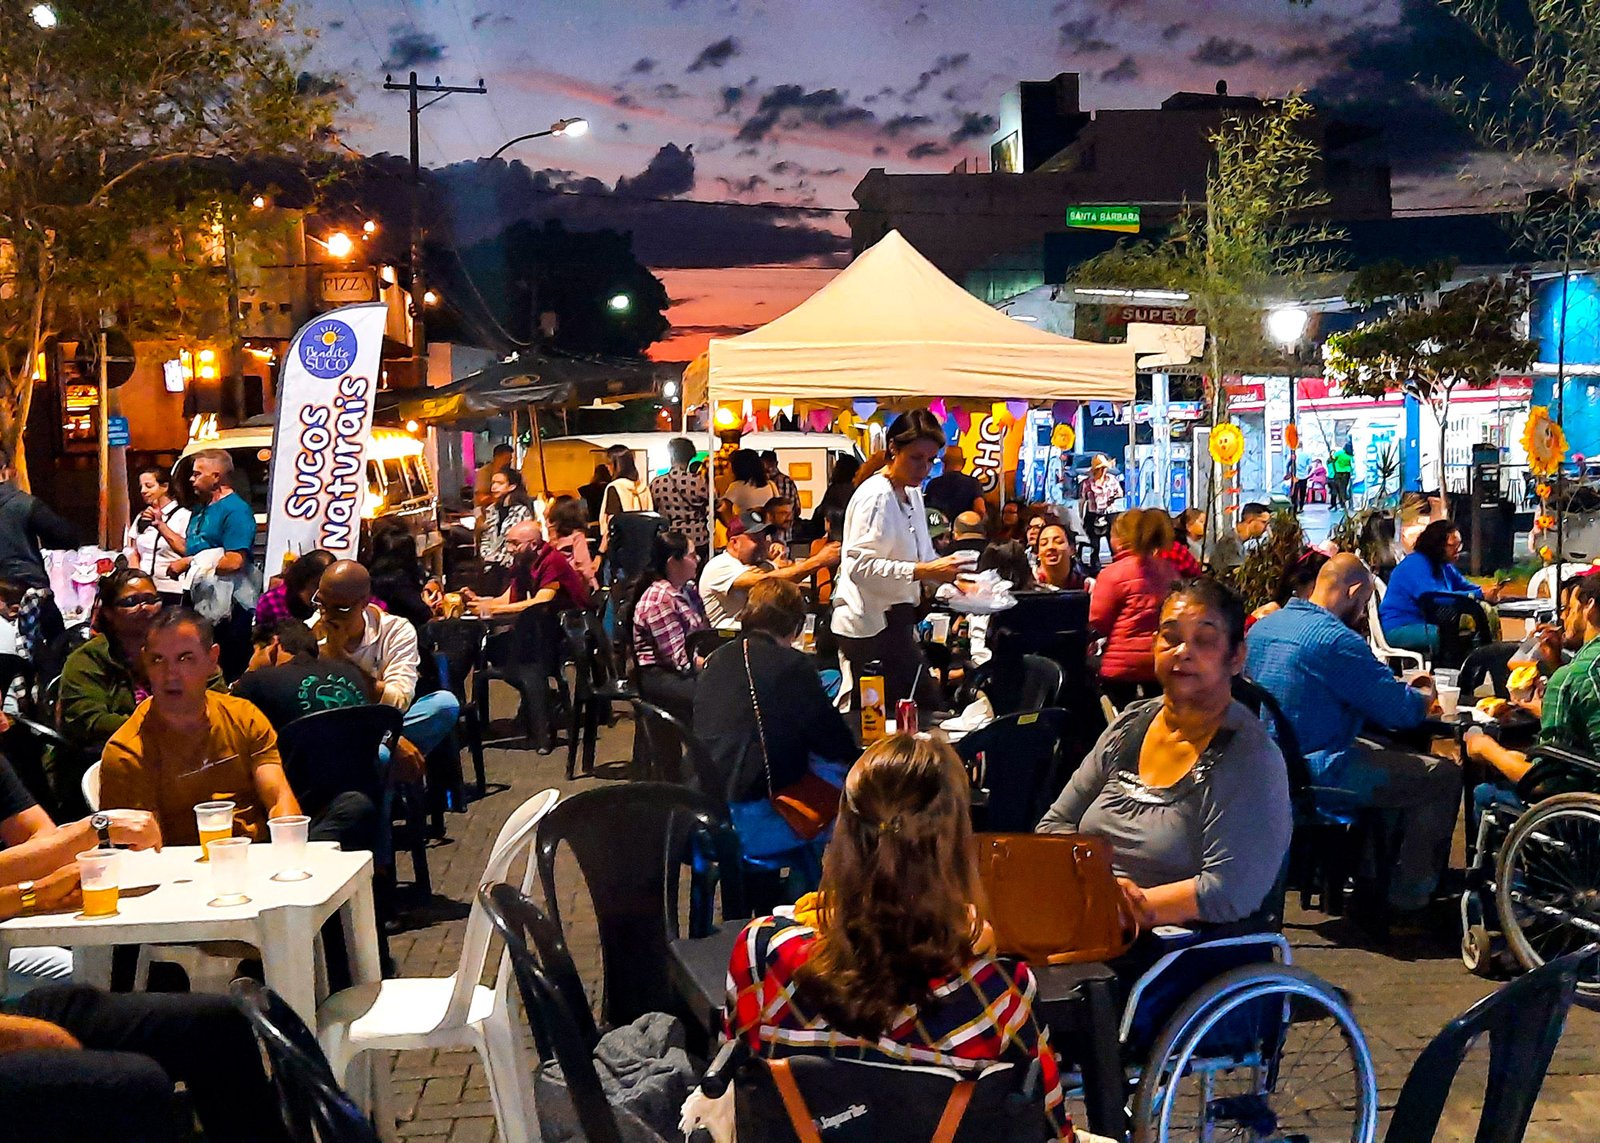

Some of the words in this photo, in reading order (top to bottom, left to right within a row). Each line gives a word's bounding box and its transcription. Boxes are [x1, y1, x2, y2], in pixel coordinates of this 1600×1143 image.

[1069, 211, 1097, 222] SANTA
[324, 277, 371, 291] PIZZA
[305, 356, 349, 371] SUCO
[286, 404, 331, 520] Sucos
[321, 376, 368, 549] Naturais
